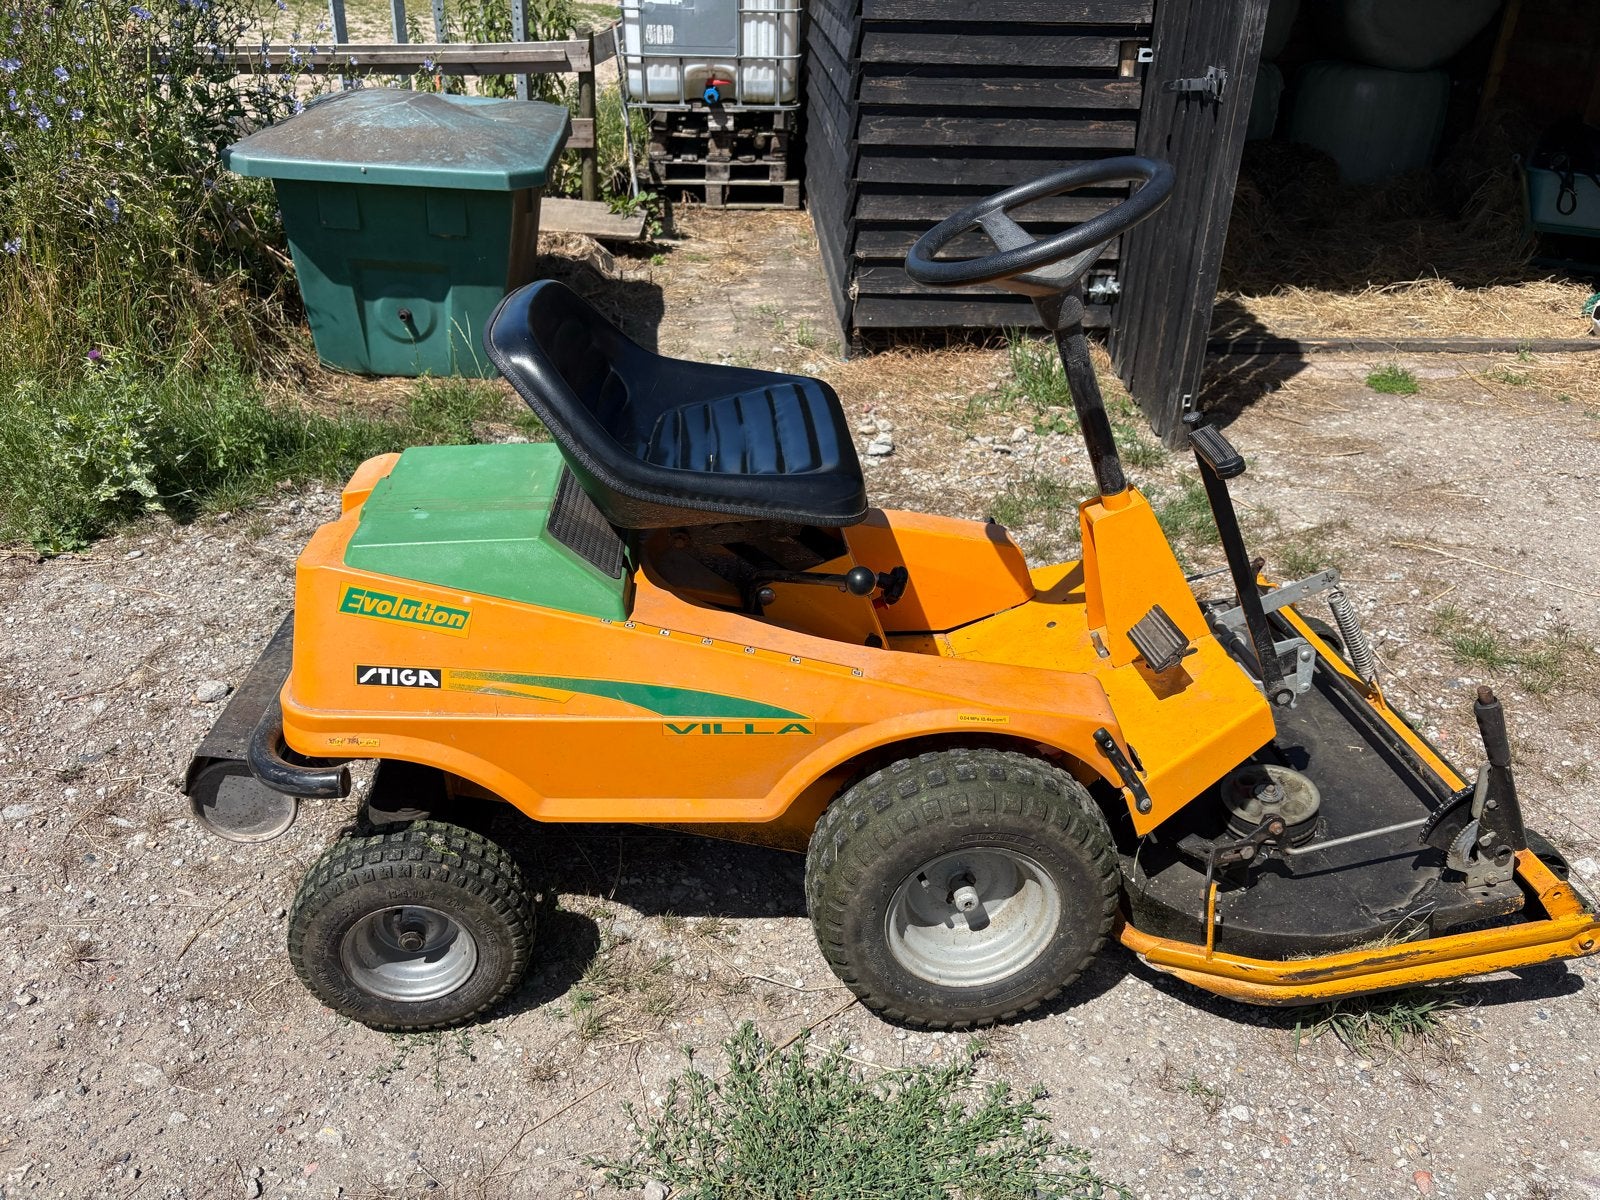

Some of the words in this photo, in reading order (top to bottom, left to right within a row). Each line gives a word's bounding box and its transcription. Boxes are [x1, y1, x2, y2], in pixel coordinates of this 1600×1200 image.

[340, 586, 469, 628] Evolution
[359, 667, 439, 687] STIGA
[663, 723, 814, 735] VILLA
